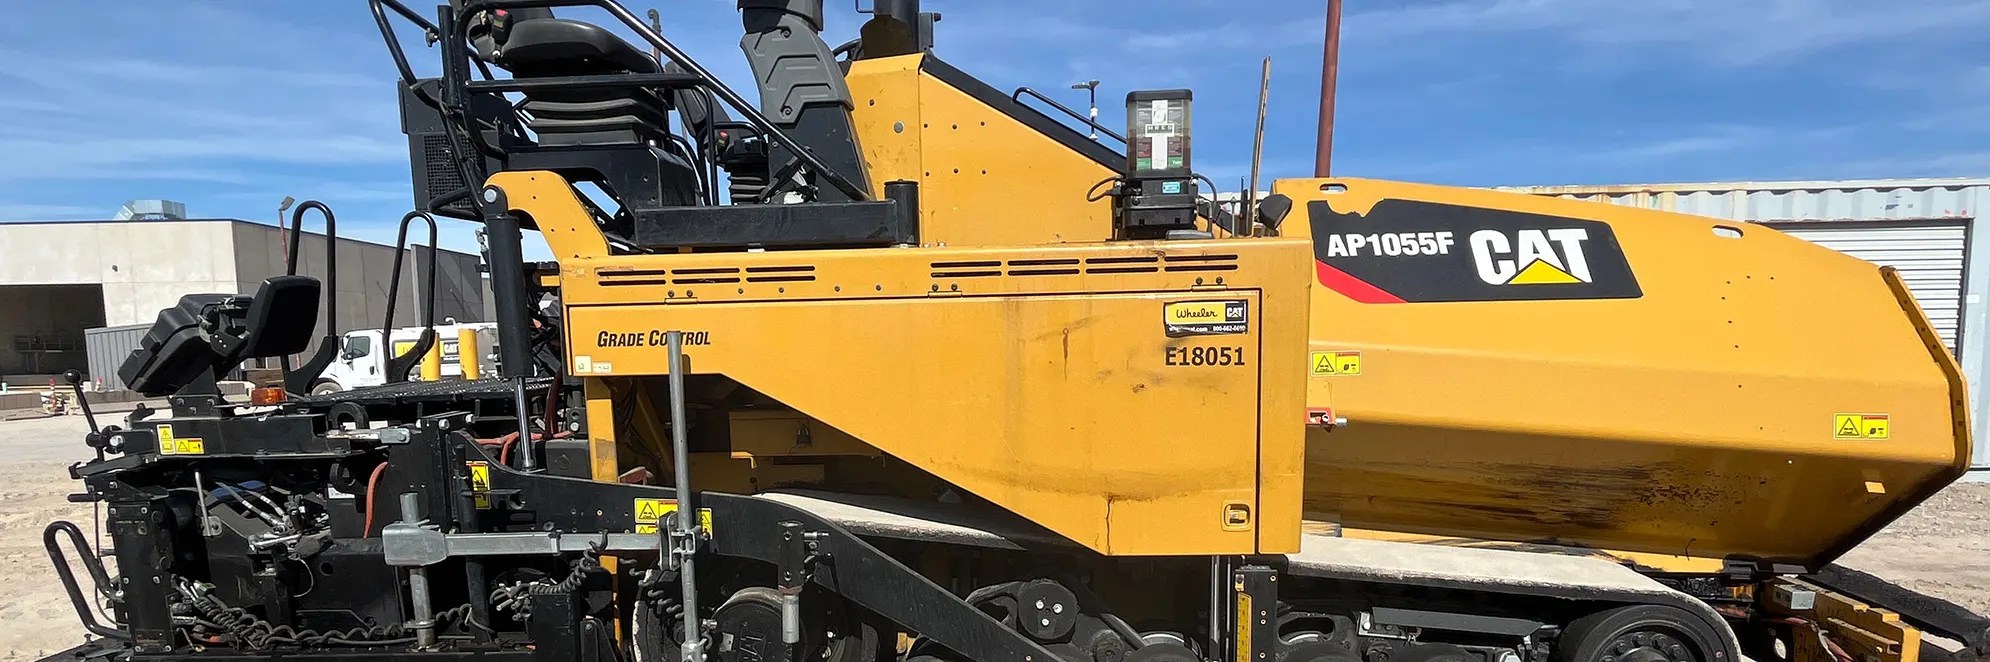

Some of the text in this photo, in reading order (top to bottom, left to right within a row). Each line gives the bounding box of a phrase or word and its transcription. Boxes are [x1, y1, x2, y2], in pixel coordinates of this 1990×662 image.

[1327, 231, 1454, 257] AP1055F
[1469, 228, 1593, 285] CAT
[1176, 307, 1244, 319] Wheeler CAT
[597, 329, 711, 348] GRADE COTROL
[1165, 346, 1245, 366] E18051
